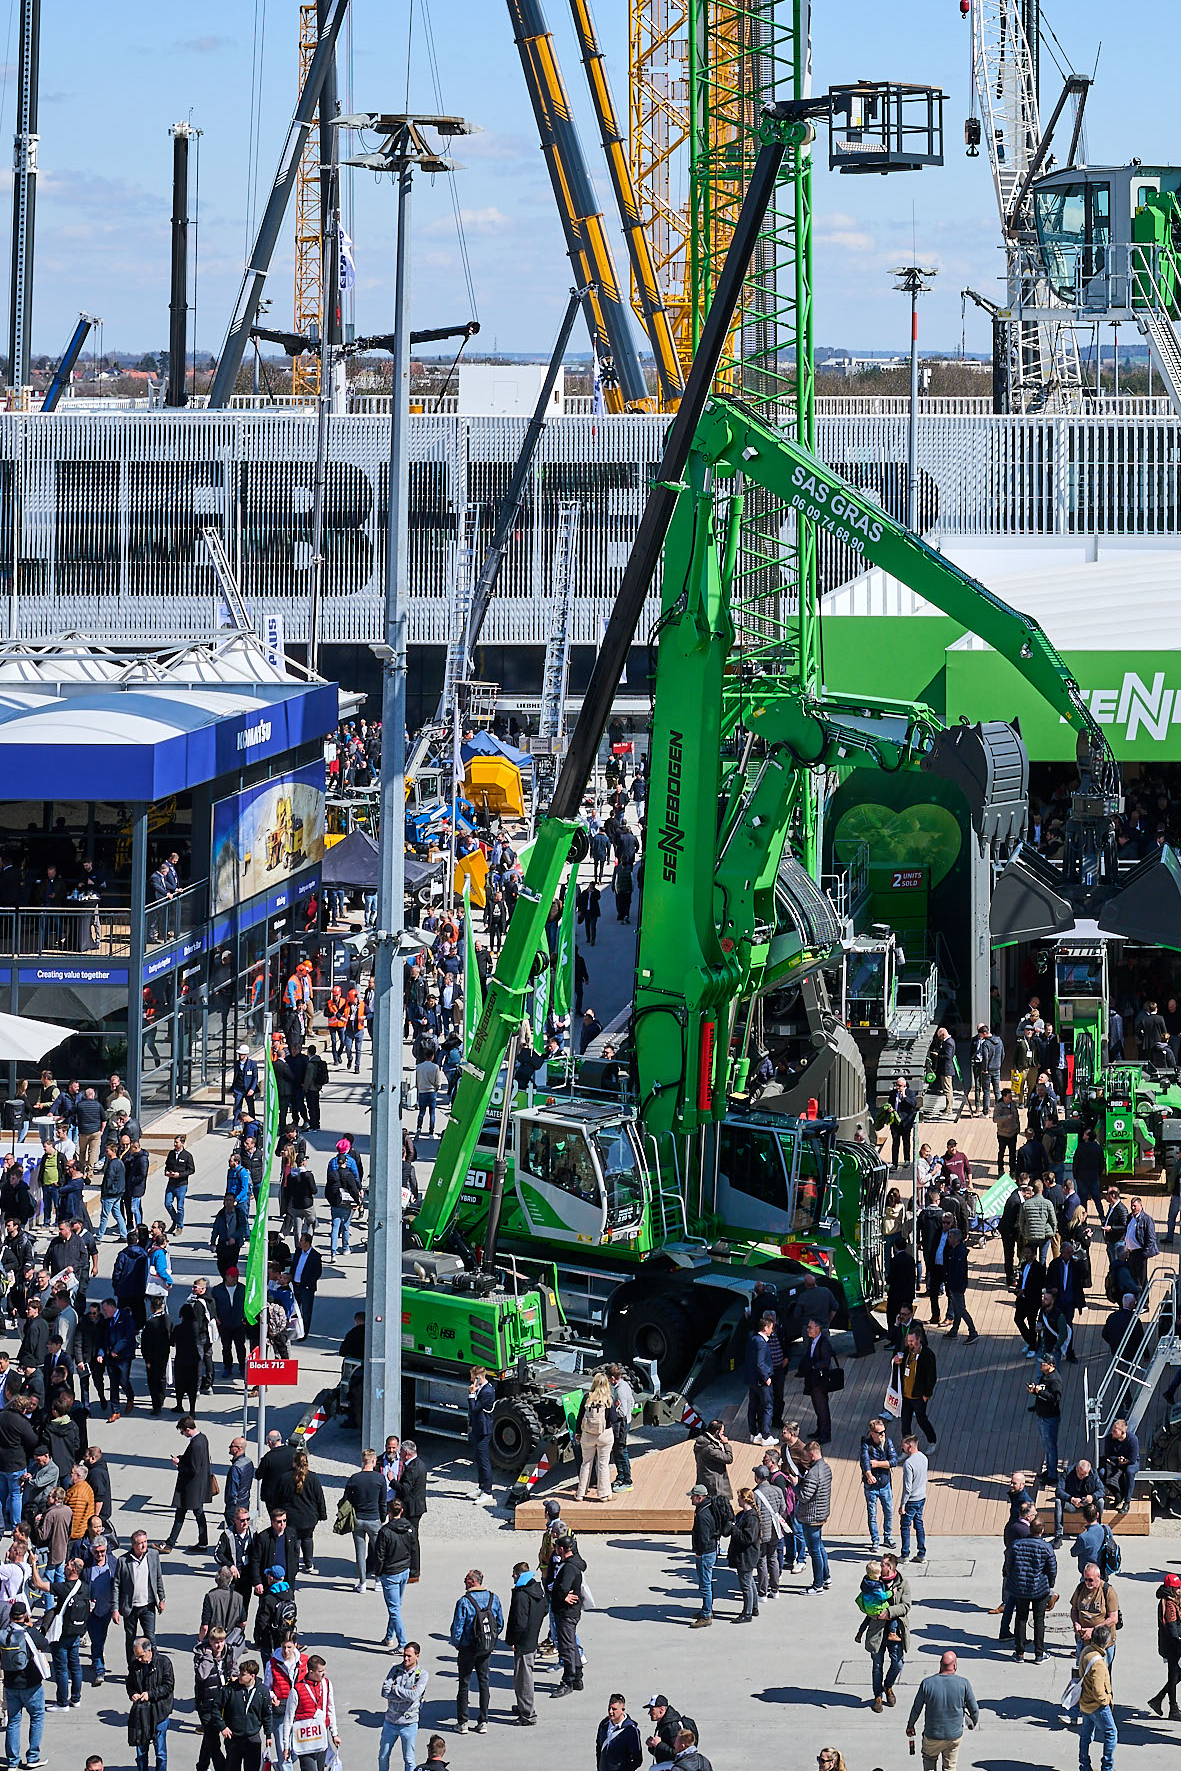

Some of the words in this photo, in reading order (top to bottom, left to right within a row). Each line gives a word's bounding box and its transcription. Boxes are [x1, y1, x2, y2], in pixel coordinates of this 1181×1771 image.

[791, 466, 830, 503] SAS
[831, 495, 884, 542] GRAS
[791, 494, 806, 510] 06
[806, 505, 821, 520] 09
[821, 515, 836, 532] 74
[836, 526, 850, 542] 68
[850, 537, 865, 553] 90
[236, 718, 272, 751] KOMATSU
[662, 730, 684, 883] SENNEBOGEN
[892, 873, 902, 887] 2
[37, 969, 63, 980] Creating
[64, 969, 80, 979] value
[80, 969, 110, 980] together
[475, 990, 498, 1054] SENNEBOGEN
[248, 1361, 266, 1370] Block
[267, 1361, 285, 1370] 712
[300, 1725, 322, 1738] PERI
